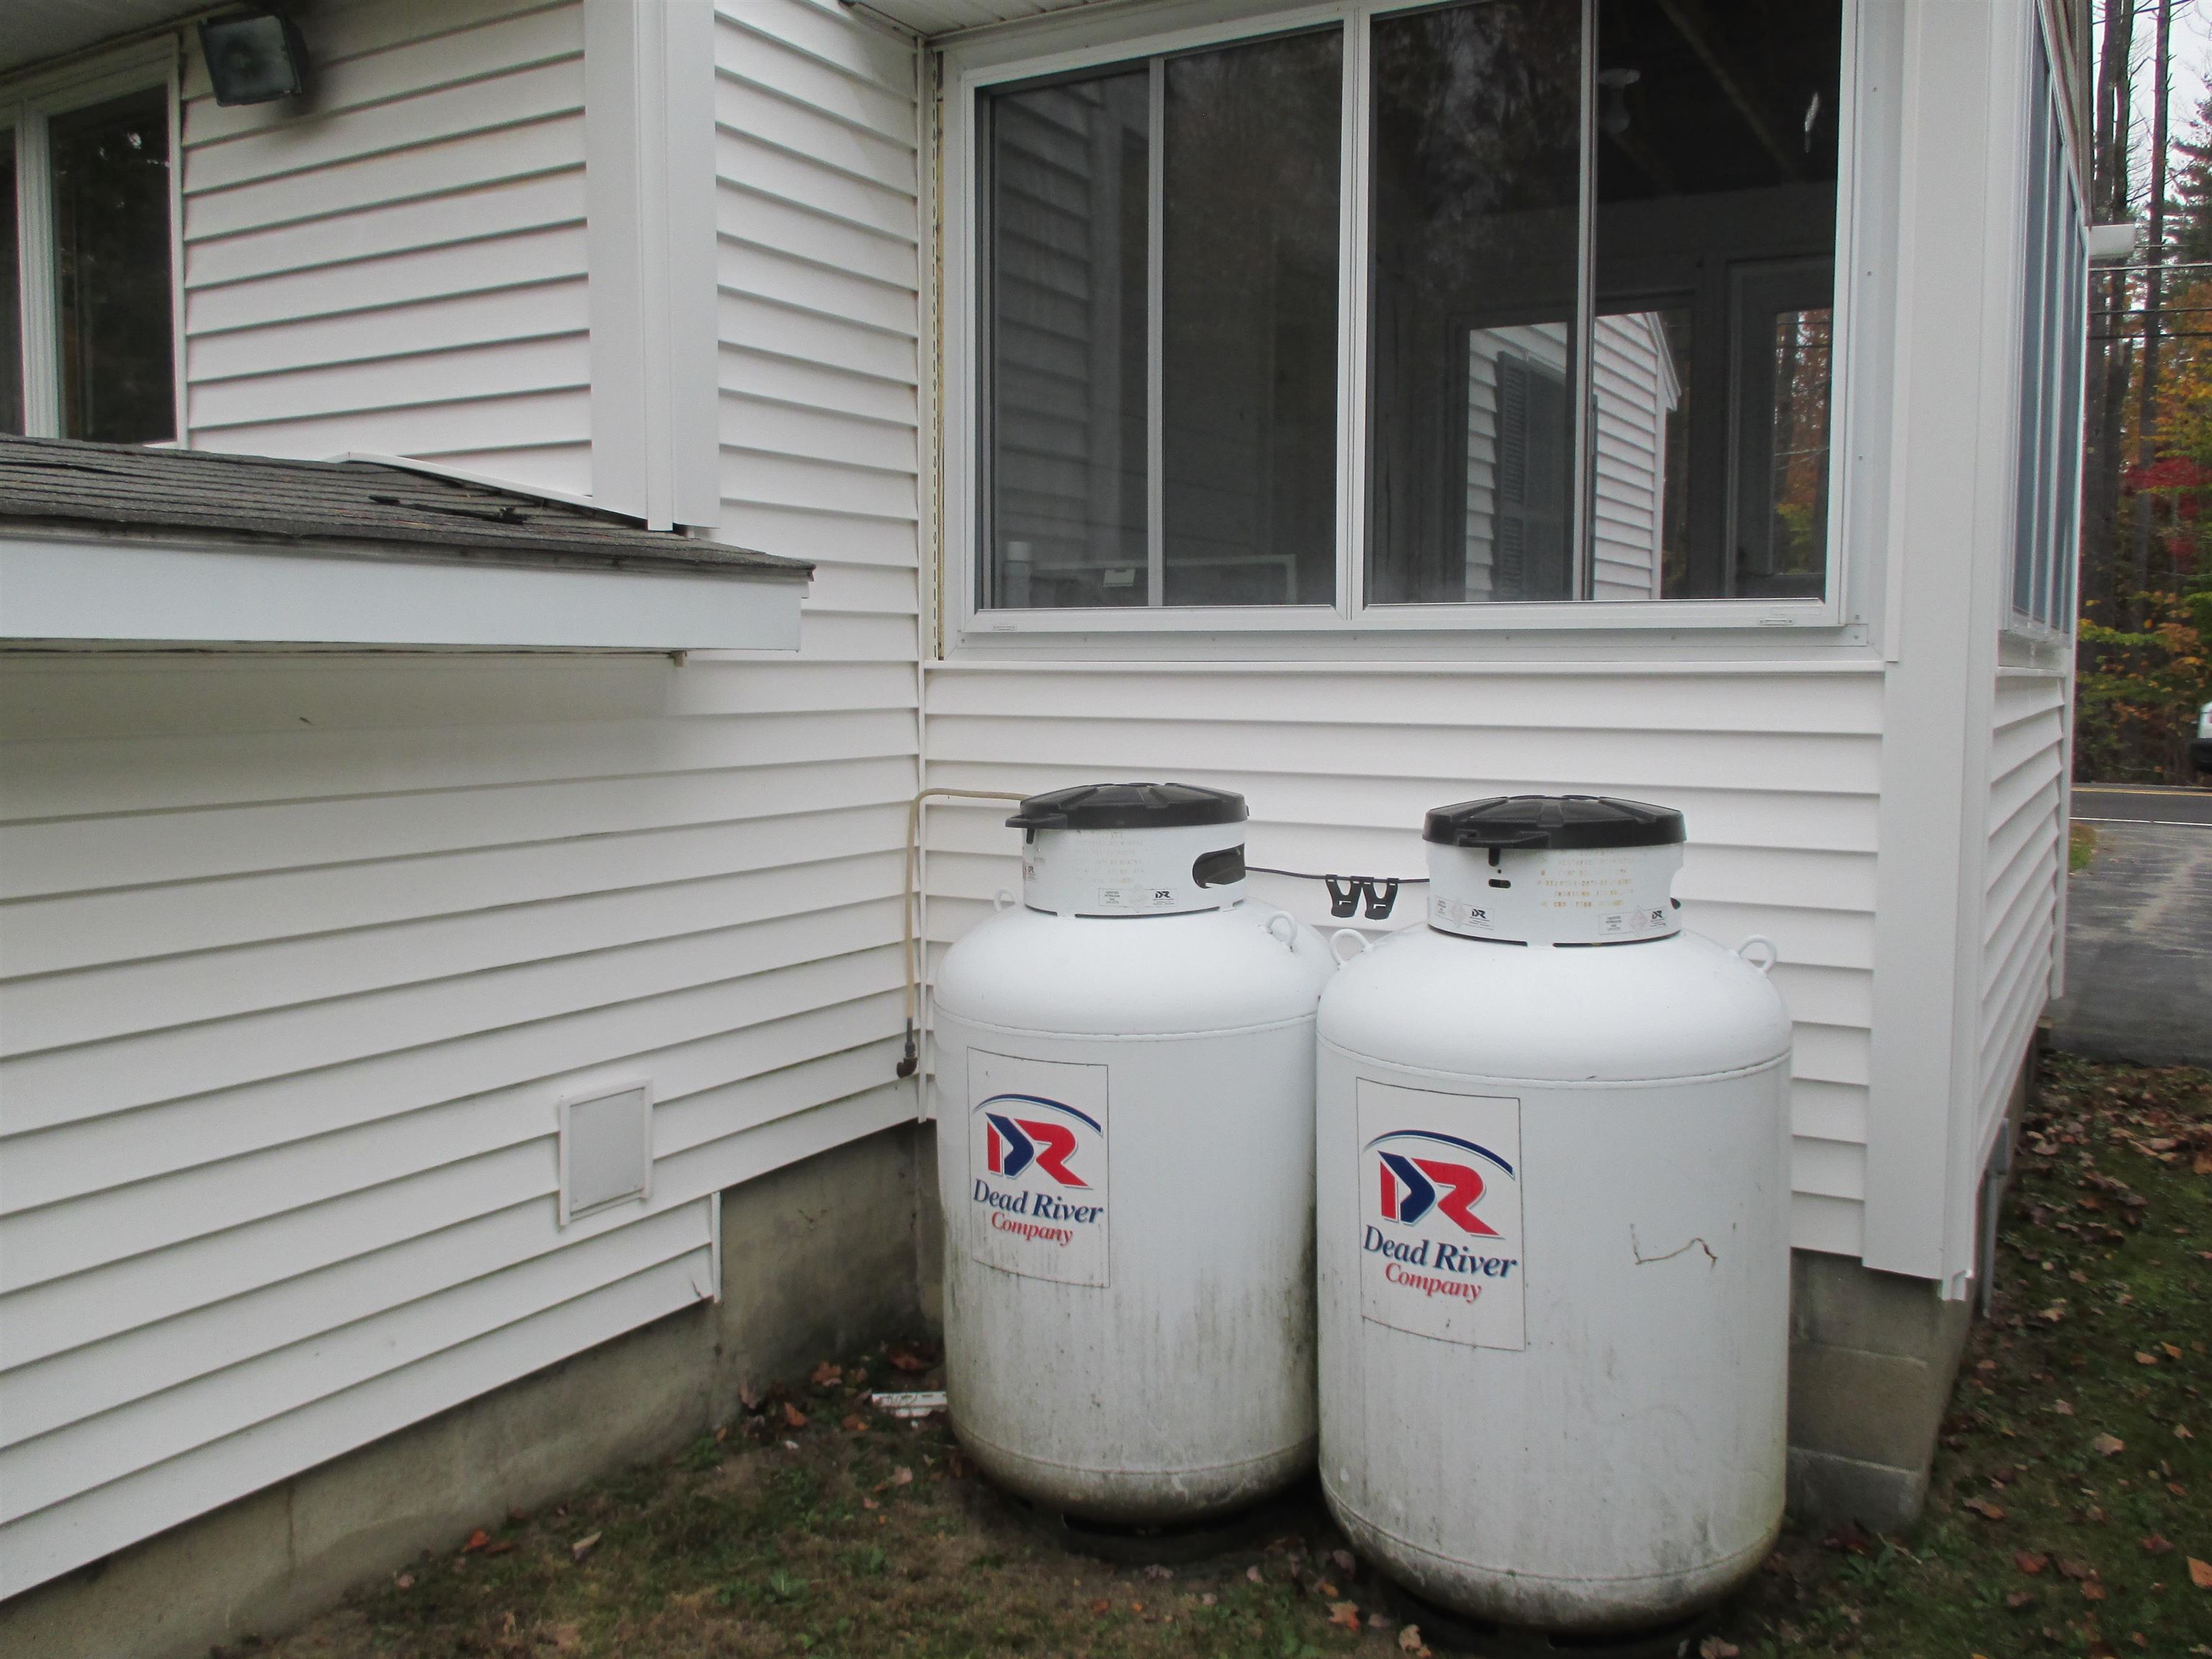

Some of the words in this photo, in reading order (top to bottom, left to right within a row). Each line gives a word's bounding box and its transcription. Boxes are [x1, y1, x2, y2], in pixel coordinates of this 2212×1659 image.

[974, 1179, 1029, 1214] Dead
[1032, 1192, 1104, 1223] River
[992, 1211, 1074, 1246] Company
[1363, 1225, 1430, 1266] Dead
[1433, 1242, 1518, 1277] River
[1385, 1262, 1483, 1304] Company
